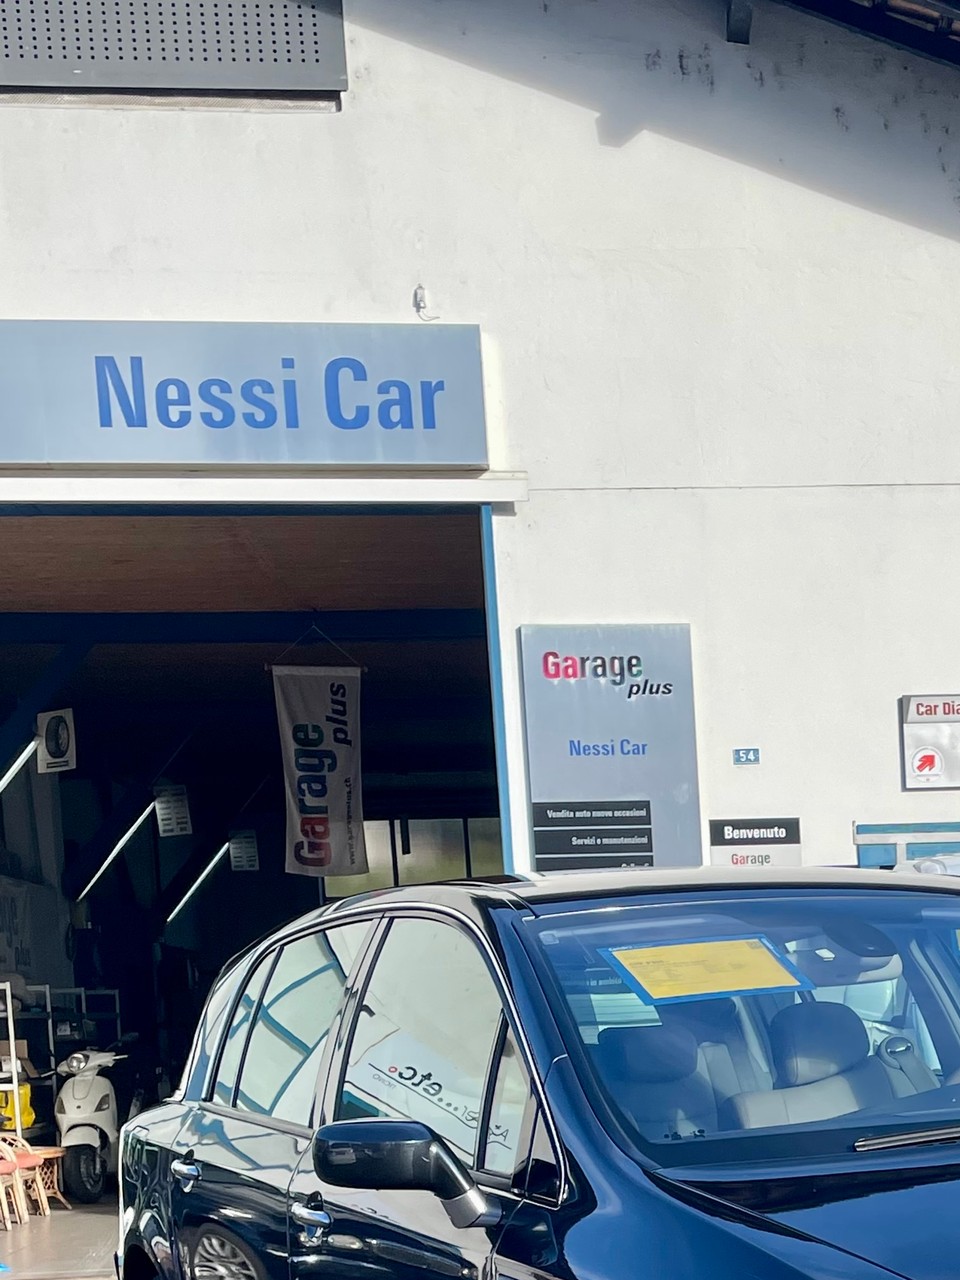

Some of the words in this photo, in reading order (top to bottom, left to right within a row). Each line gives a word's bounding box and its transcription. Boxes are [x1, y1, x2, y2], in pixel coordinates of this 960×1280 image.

[94, 355, 300, 429] Nessi
[324, 356, 445, 430] Car
[542, 651, 643, 685] Garage
[628, 679, 673, 698] plus
[325, 682, 353, 747] plus
[916, 702, 939, 716] Car
[569, 739, 615, 756] Nessi
[620, 739, 648, 756] Car
[739, 750, 756, 762] 54
[292, 722, 337, 867] Garage
[547, 809, 574, 818] Vendita
[575, 810, 591, 818] auto
[614, 807, 647, 817] occasioni
[571, 836, 596, 845] Servizi
[724, 826, 786, 840] Benvenuto
[731, 853, 771, 865] Garage
